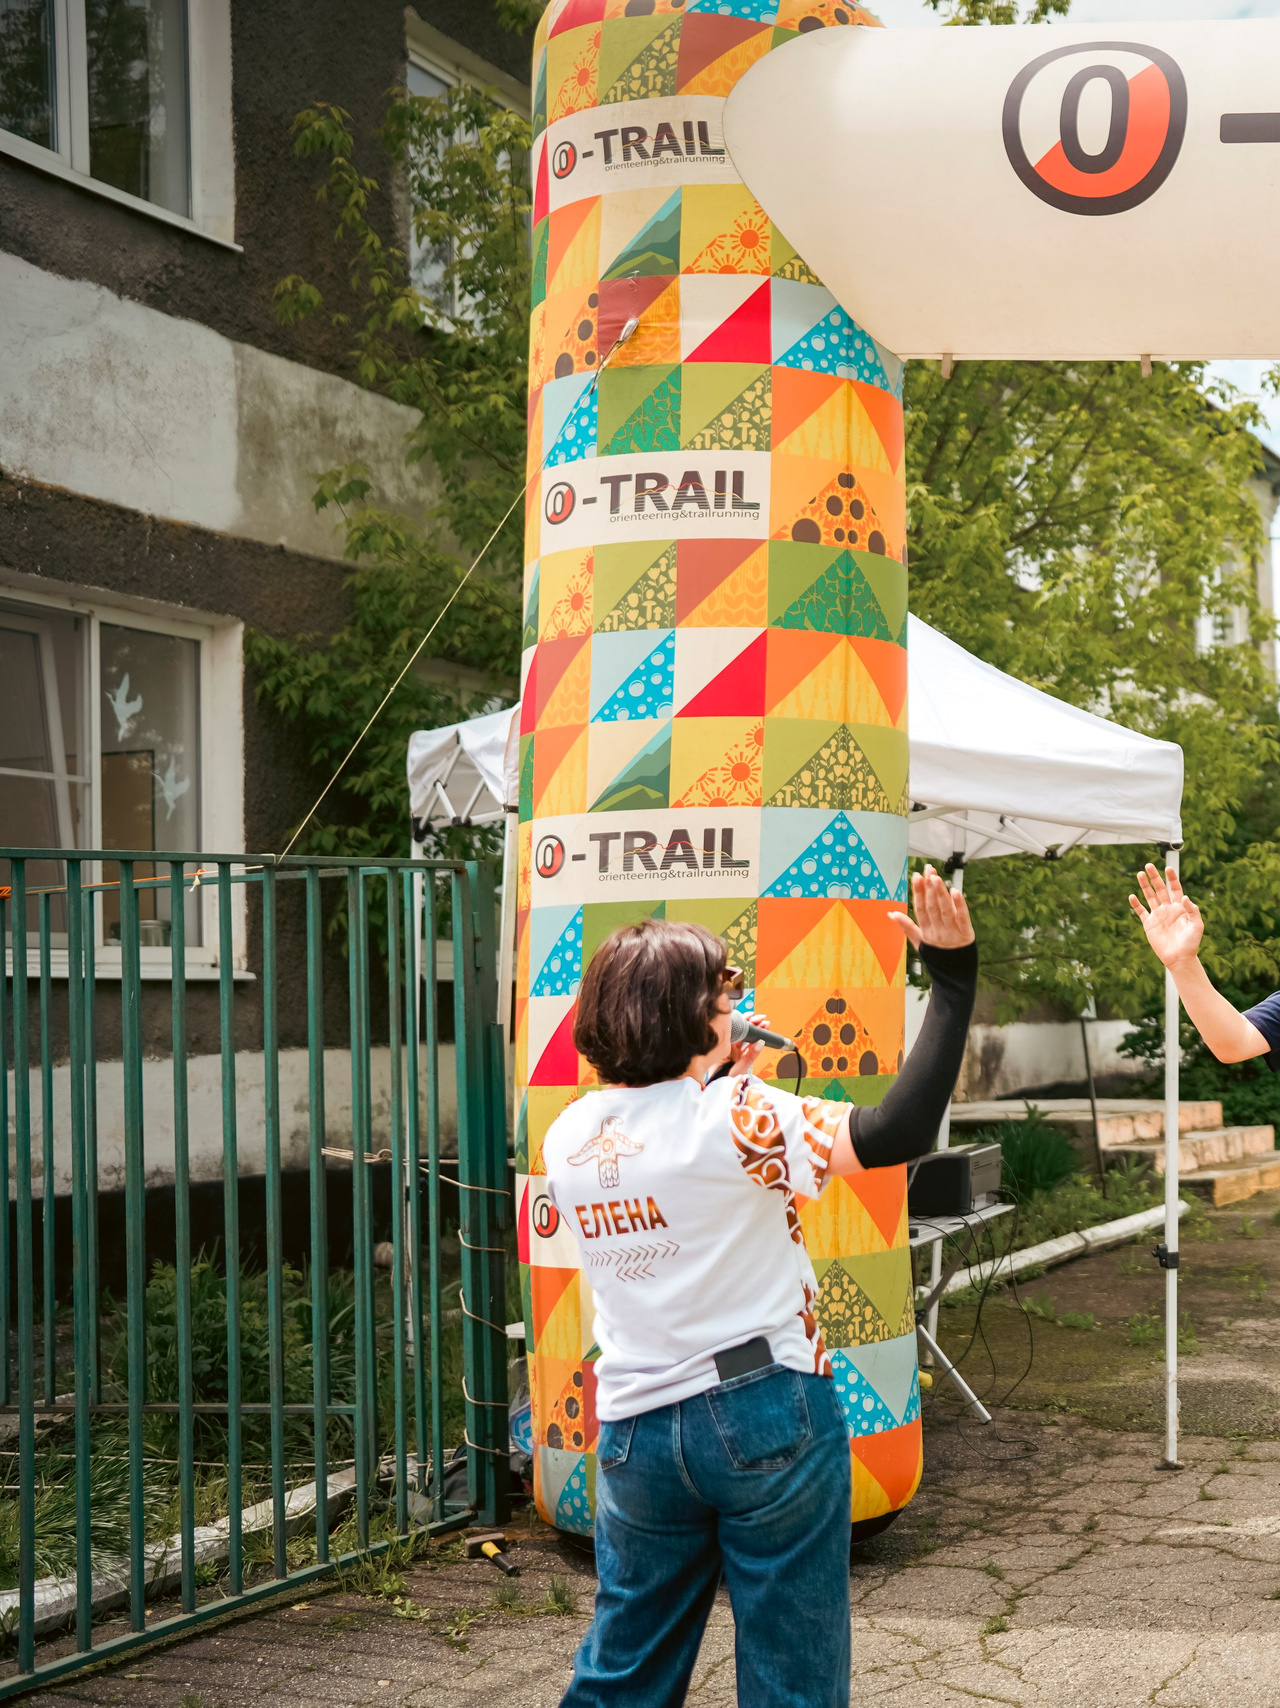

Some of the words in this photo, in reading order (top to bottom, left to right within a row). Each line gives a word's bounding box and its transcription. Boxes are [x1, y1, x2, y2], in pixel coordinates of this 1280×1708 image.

[604, 154, 726, 172] orienteering&trailrunning
[610, 509, 760, 523] orienteering&trailrunning
[598, 868, 749, 882] orienteering&trailrunning
[574, 1196, 669, 1239] ЕЛЕНА
